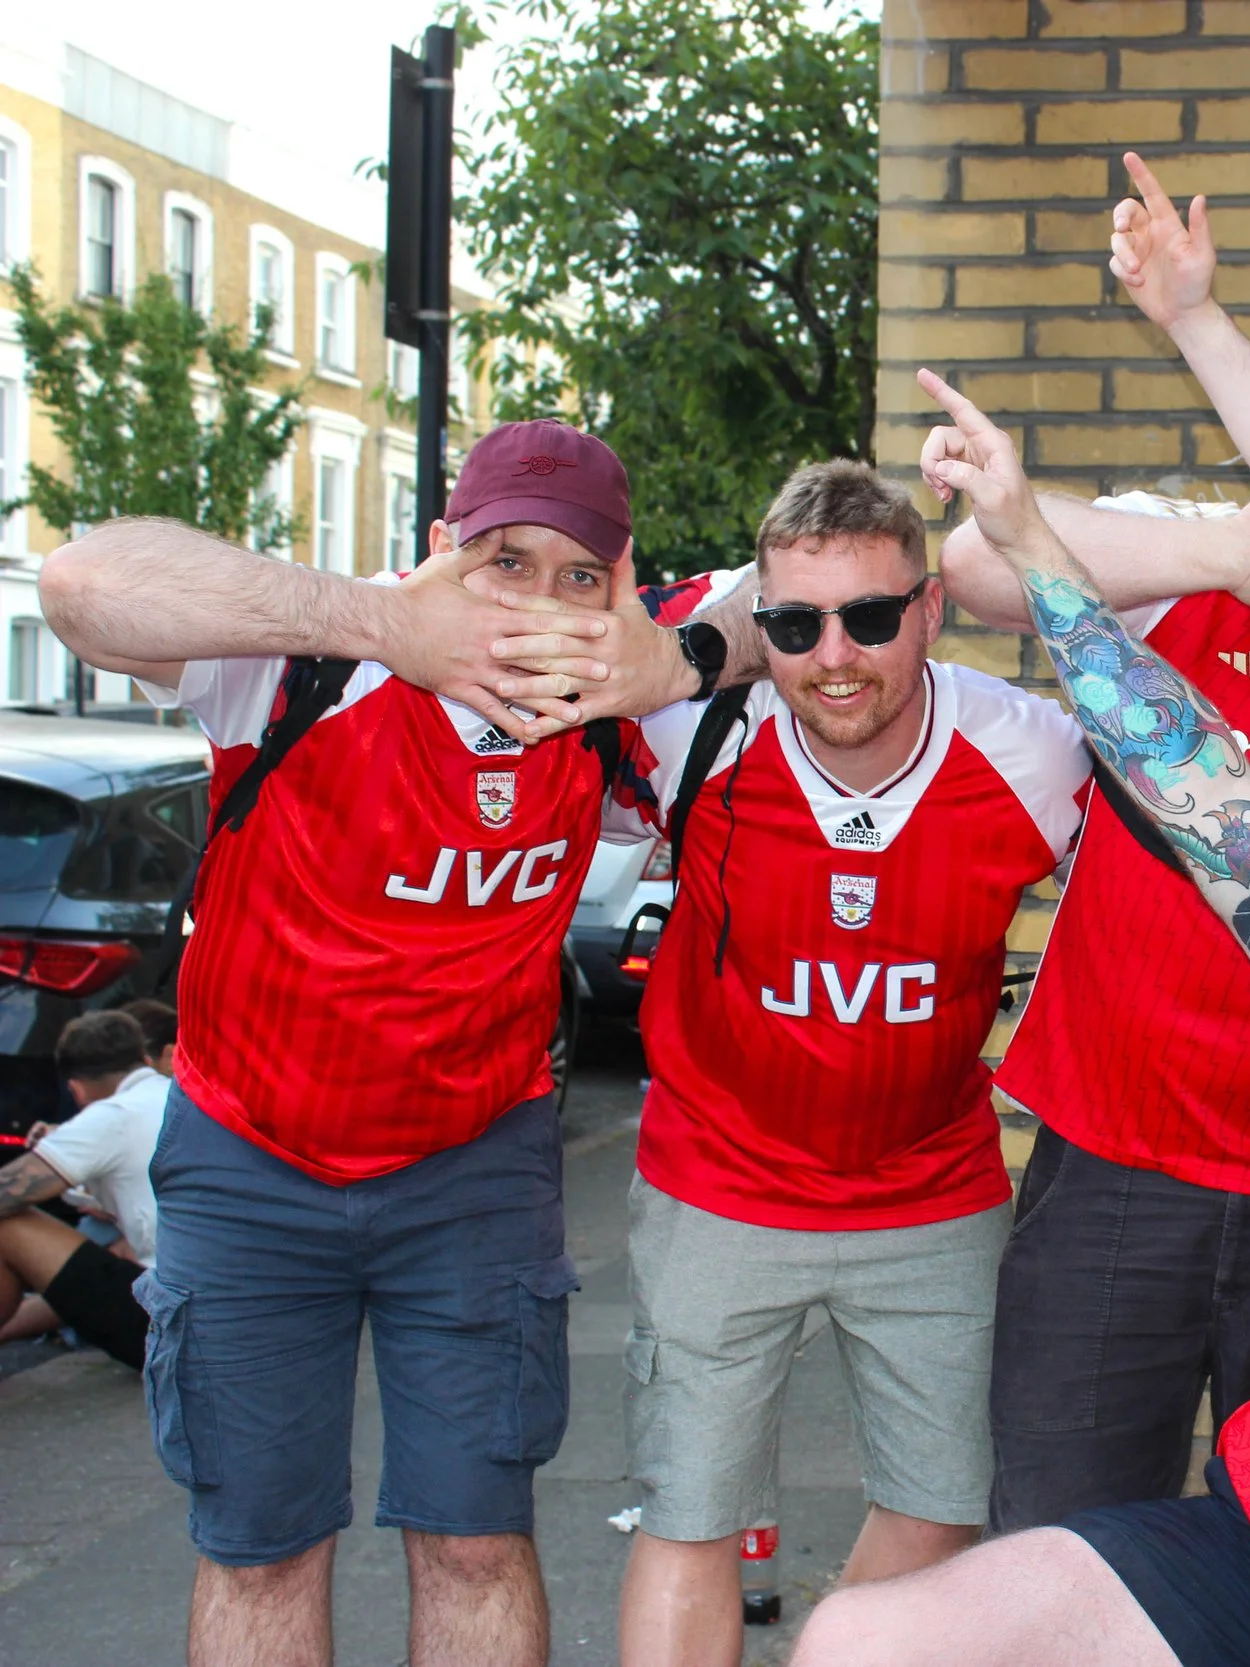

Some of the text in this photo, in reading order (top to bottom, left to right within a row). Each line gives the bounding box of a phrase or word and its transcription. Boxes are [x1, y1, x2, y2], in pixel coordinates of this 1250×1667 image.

[480, 774, 514, 784] Arsenal
[835, 827, 881, 841] adidas
[835, 837, 881, 847] EQUIPMENT
[384, 839, 568, 906] JVC
[833, 876, 875, 889] Arsenal
[761, 958, 937, 1025] JVC
